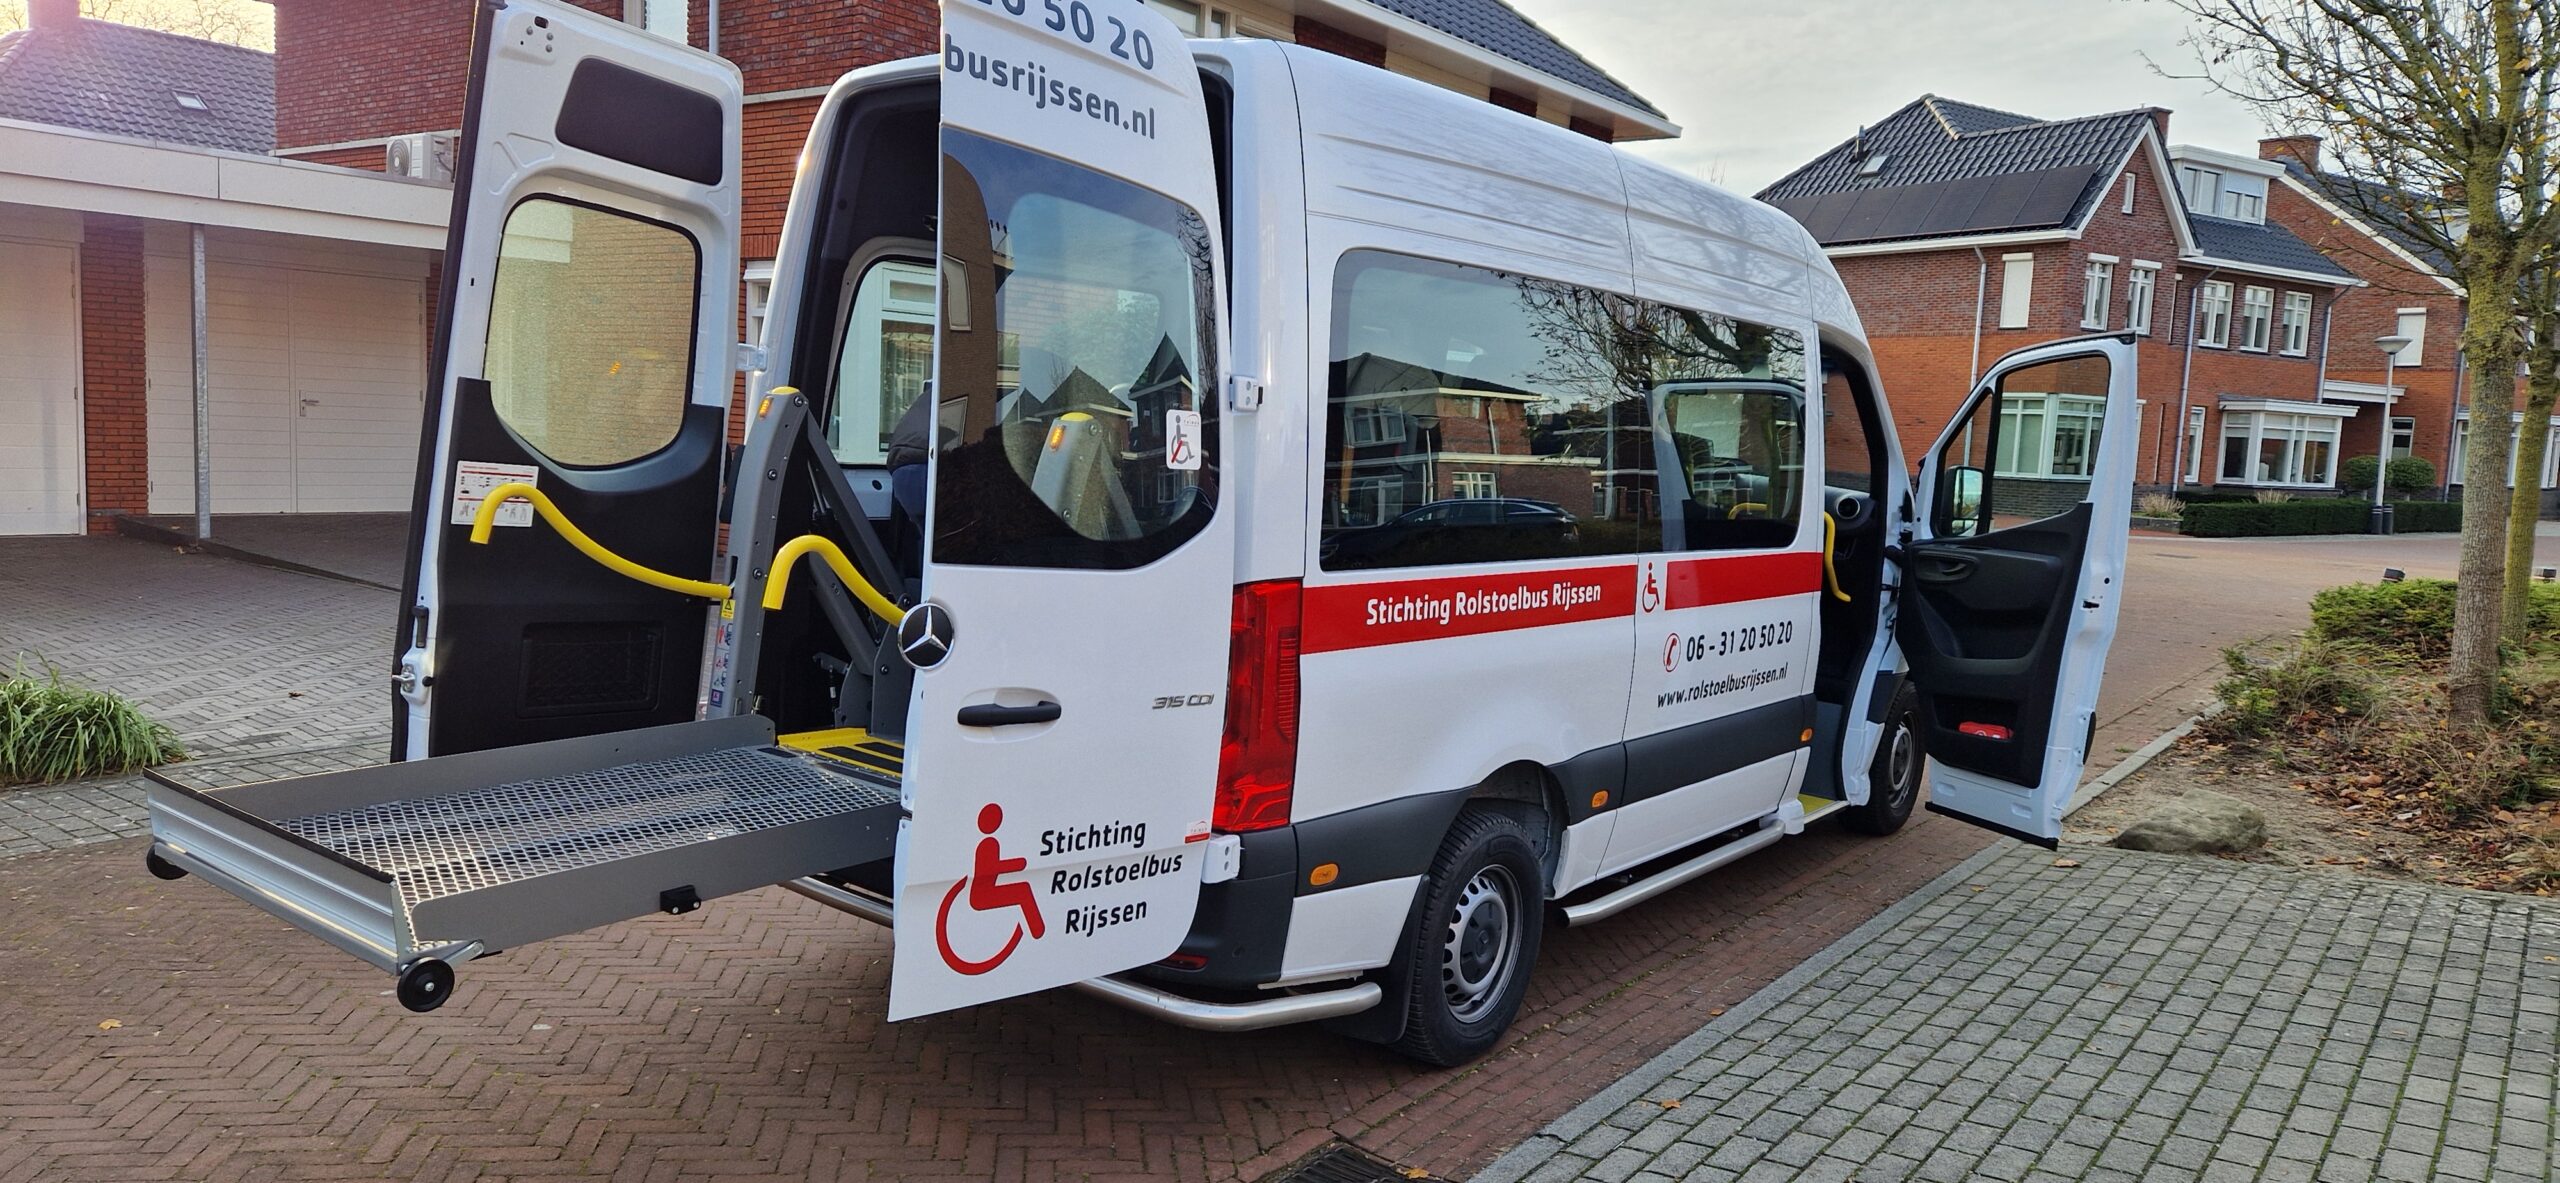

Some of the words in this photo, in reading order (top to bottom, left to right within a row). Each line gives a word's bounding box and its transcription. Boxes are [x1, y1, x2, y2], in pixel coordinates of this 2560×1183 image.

[1044, 0, 1095, 44] 50
[1107, 15, 1154, 71] 20
[944, 33, 1155, 140] busrijssen.nl
[1366, 594, 1451, 626] Stichting
[1455, 585, 1549, 616] Rolstoelbus
[1552, 581, 1601, 611] Rijssen
[1686, 634, 1705, 662] 06
[1718, 630, 1735, 657] 31
[1738, 626, 1757, 653] 20
[1758, 623, 1775, 649] 50
[1776, 620, 1793, 645] 20
[1152, 695, 1185, 710] 315
[1187, 693, 1215, 707] CDI
[1657, 661, 1789, 709] www.rolstoelbusrijssen.nl
[1039, 820, 1146, 857] Stichting
[1050, 854, 1183, 895] Rolstoelbus
[1065, 901, 1147, 938] Rijssen
